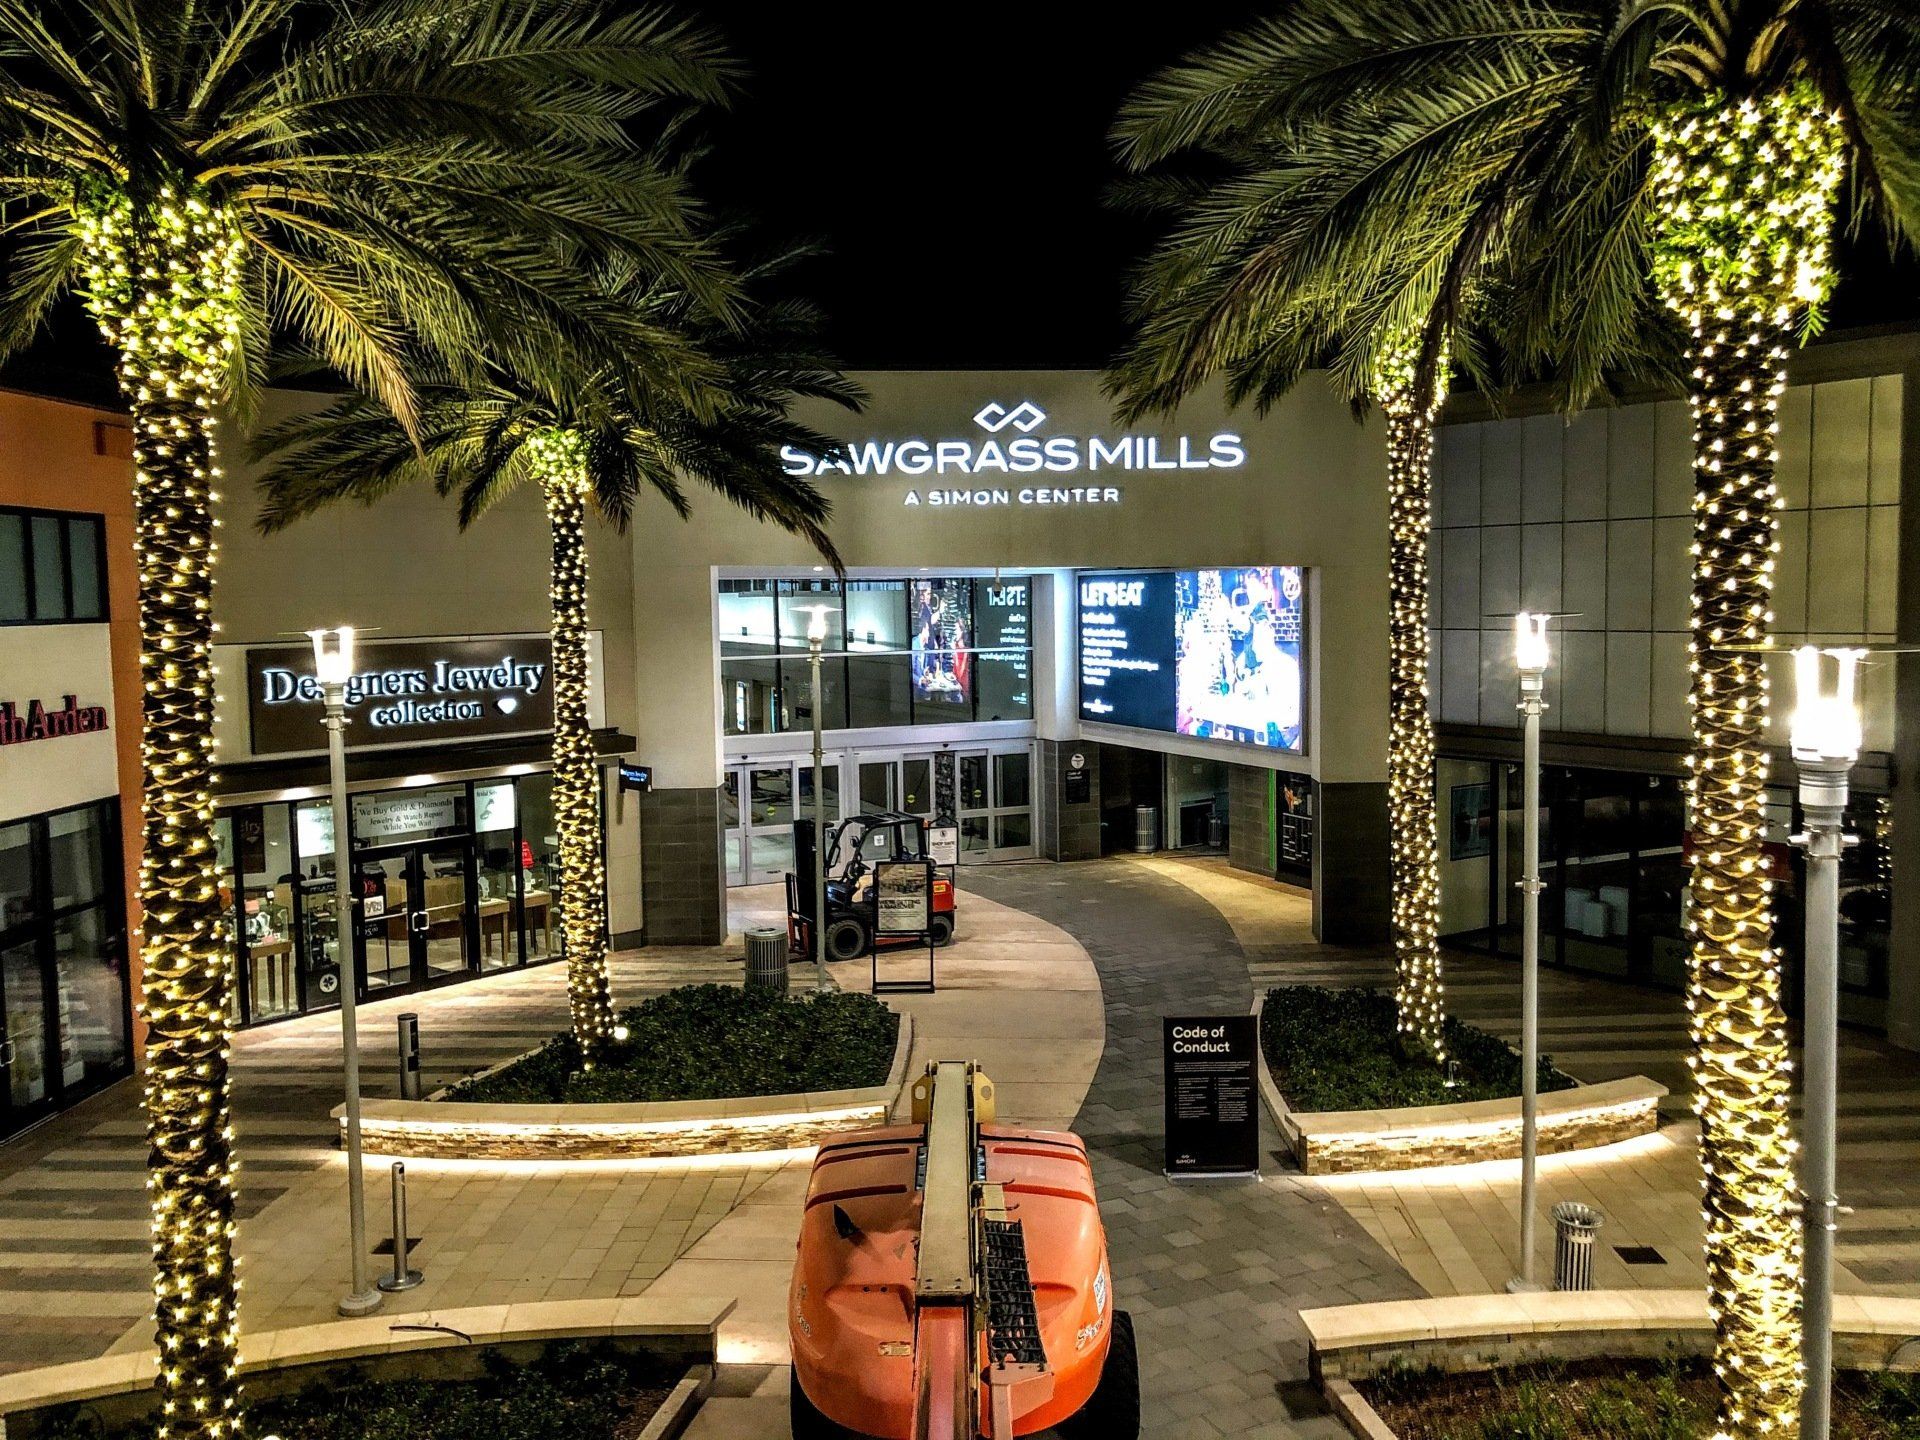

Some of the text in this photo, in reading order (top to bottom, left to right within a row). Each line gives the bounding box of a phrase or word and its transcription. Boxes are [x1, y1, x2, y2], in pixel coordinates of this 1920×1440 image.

[780, 434, 1245, 475] SAWGRASS MILLS
[904, 487, 1119, 505] A SIMON CENTER
[434, 656, 547, 694] Jewelry
[25, 695, 109, 740] Arden
[371, 698, 484, 727] collection
[359, 808, 372, 817] We
[373, 806, 388, 816] Buy
[390, 803, 409, 813] Gold
[418, 798, 453, 809] Diamonds
[369, 816, 394, 826] Jewelry
[403, 813, 423, 822] Watch
[423, 810, 444, 820] Repair
[1172, 1026, 1225, 1039] Code of
[1173, 1041, 1231, 1053] Conduct
